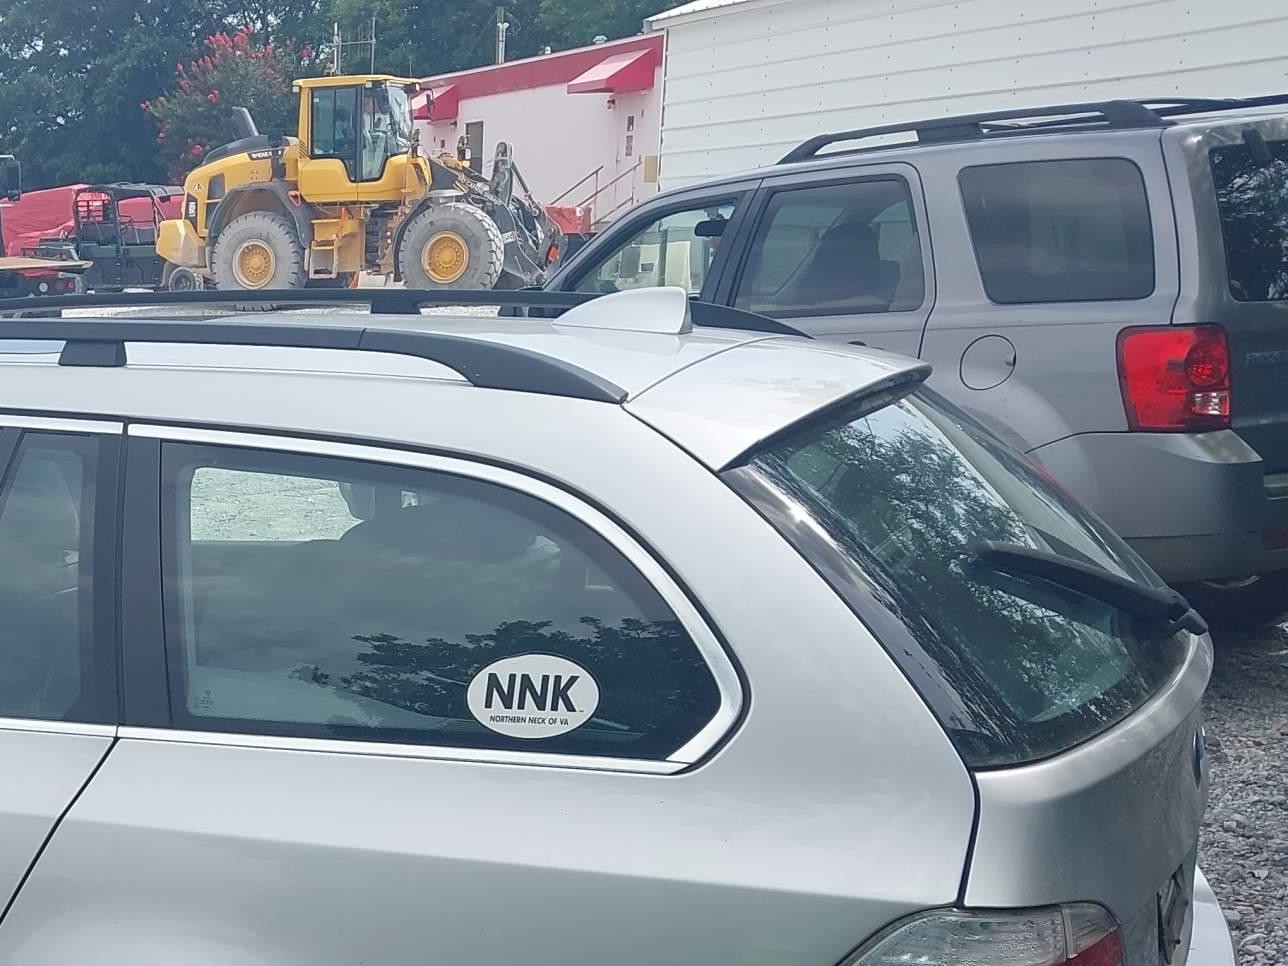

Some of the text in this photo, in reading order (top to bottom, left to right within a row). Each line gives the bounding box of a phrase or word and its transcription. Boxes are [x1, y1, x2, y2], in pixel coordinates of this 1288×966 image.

[484, 672, 581, 713] NNK
[489, 715, 569, 726] NORTHERN NECK OF VA
